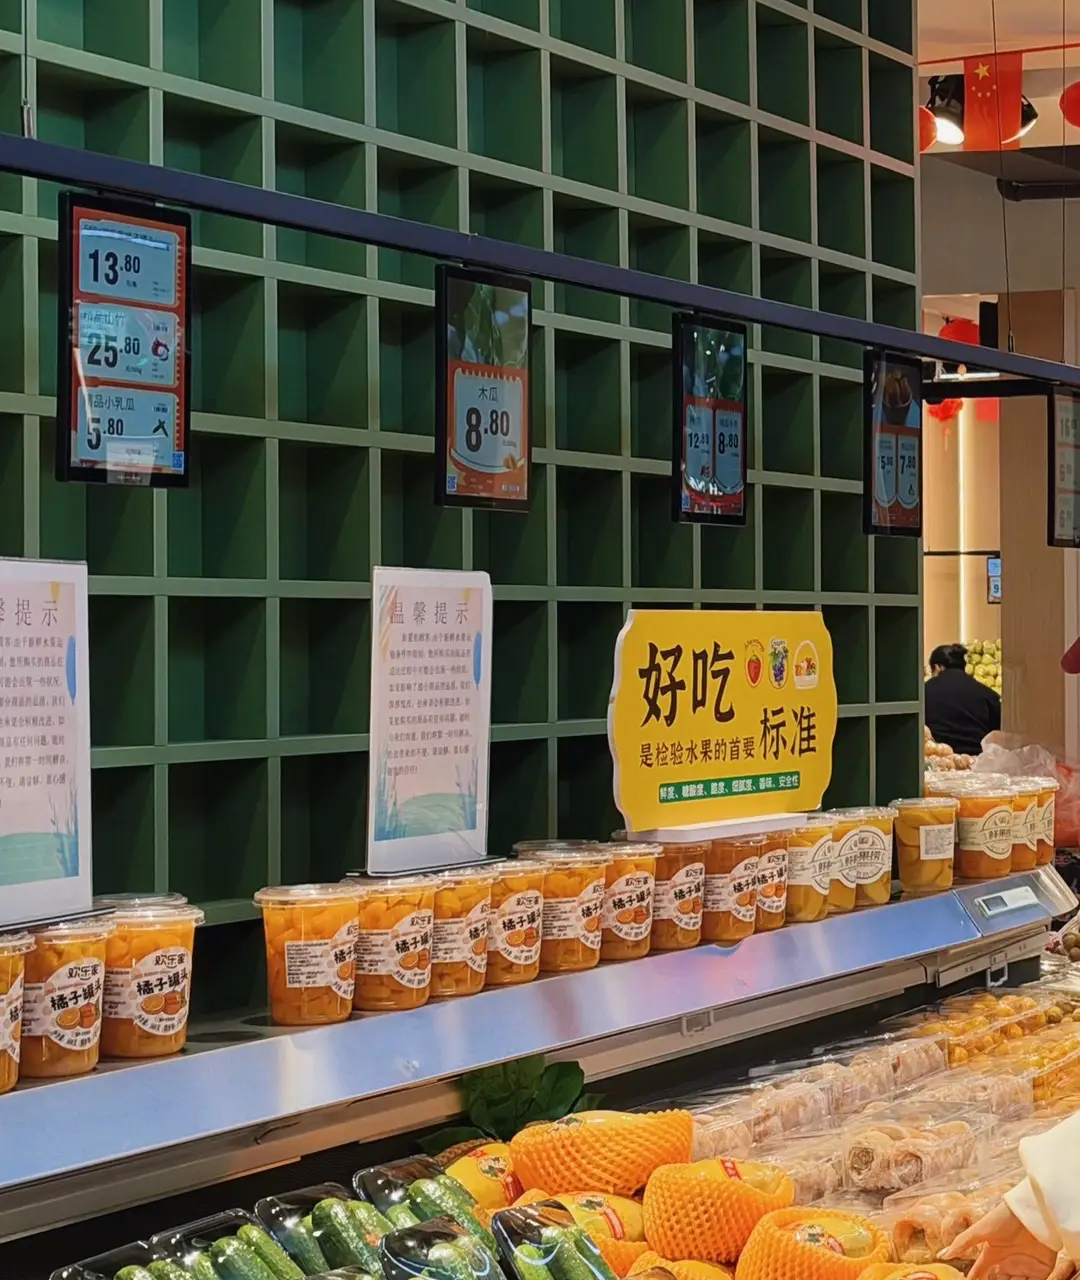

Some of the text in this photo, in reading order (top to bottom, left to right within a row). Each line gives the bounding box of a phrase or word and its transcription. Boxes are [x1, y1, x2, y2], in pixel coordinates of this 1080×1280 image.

[88, 249, 141, 285] 13.80
[87, 333, 141, 368] 25.80
[478, 384, 499, 402] 木瓜
[86, 417, 124, 451] 5.80
[465, 406, 510, 453] 8.80
[390, 600, 469, 625] 温馨提示
[638, 640, 736, 728] 好吃
[759, 705, 817, 761] 标准
[639, 736, 756, 768] 是检验水果的首要
[67, 963, 100, 981] 欢乐家
[154, 952, 187, 969] 欢乐家
[136, 967, 189, 997] 橘子罐头
